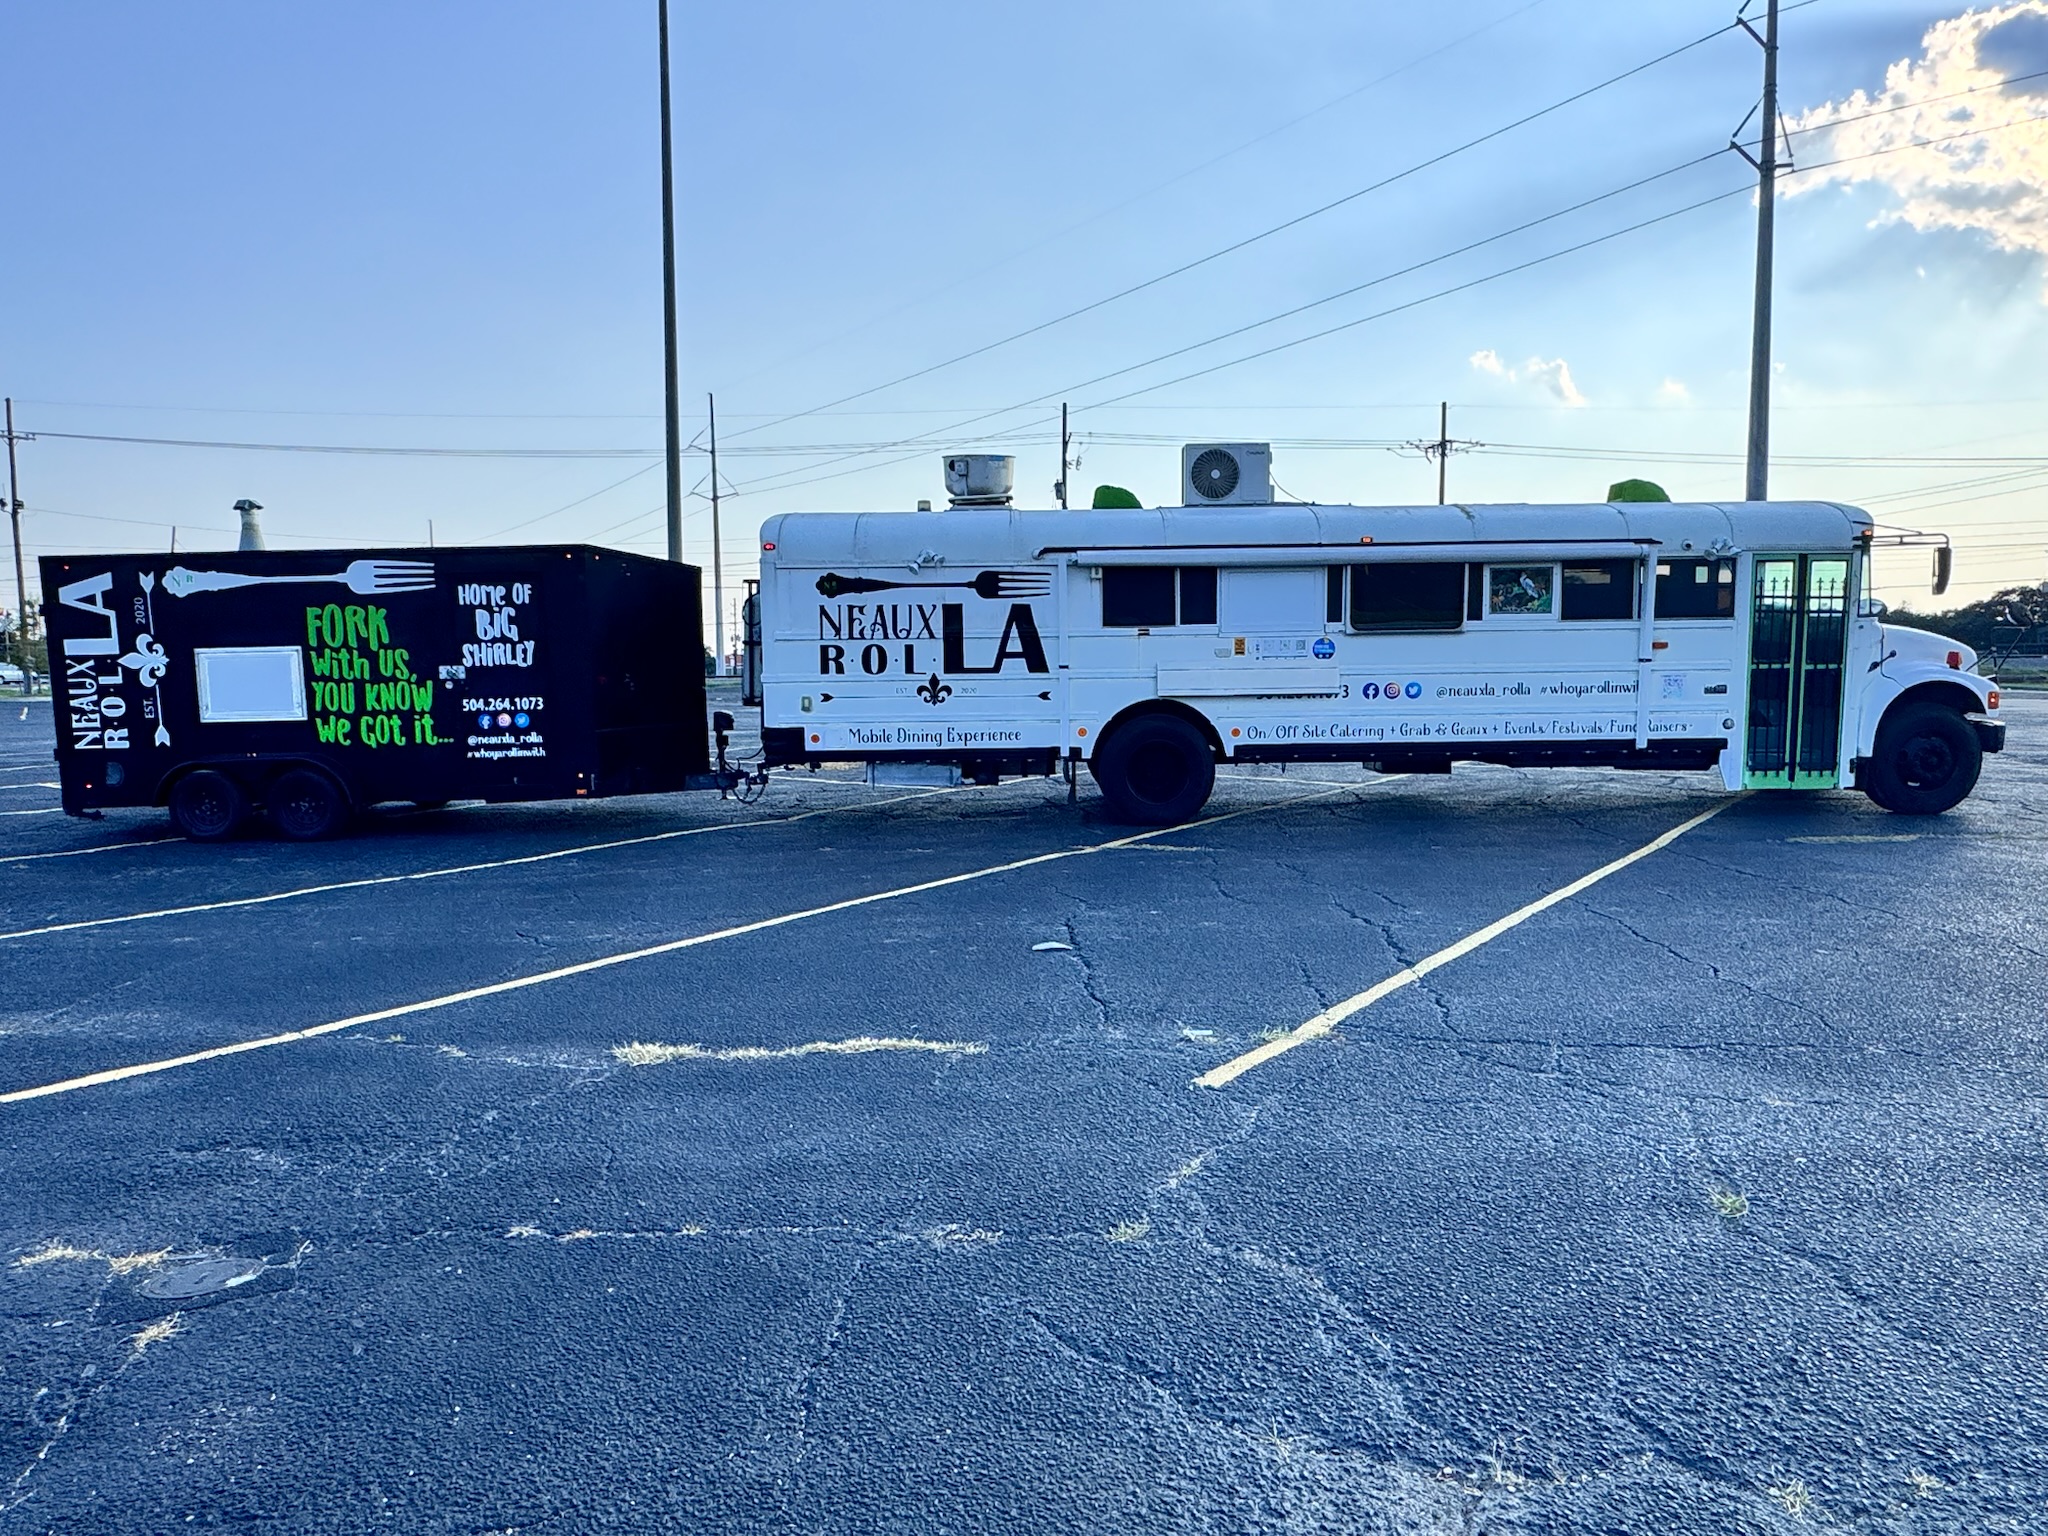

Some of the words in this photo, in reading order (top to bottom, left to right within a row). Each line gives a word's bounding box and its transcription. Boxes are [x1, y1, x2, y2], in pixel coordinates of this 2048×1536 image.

[512, 582, 532, 605] OF
[58, 571, 120, 656] LA
[133, 597, 146, 624] 2020
[818, 604, 937, 640] NEAUX
[306, 603, 390, 651] FORK
[942, 603, 1050, 674] LA
[311, 681, 355, 714] YOU
[365, 680, 433, 712] KNOW
[1436, 682, 1531, 699] @neauxla_rolla
[65, 659, 103, 749] NEAUX
[143, 697, 155, 719] EST.
[462, 697, 544, 712] 504.264.1073
[467, 731, 543, 746] @neauxla_rolla
[848, 728, 893, 744] Mobile
[897, 727, 943, 747] Dining
[947, 726, 1022, 747] Experience
[1247, 725, 1299, 739] On/Off
[1302, 724, 1327, 738] Site
[1330, 723, 1384, 741] Catering
[1400, 722, 1431, 736] Grab
[1434, 723, 1448, 736] &
[1451, 721, 1488, 735] Geaux
